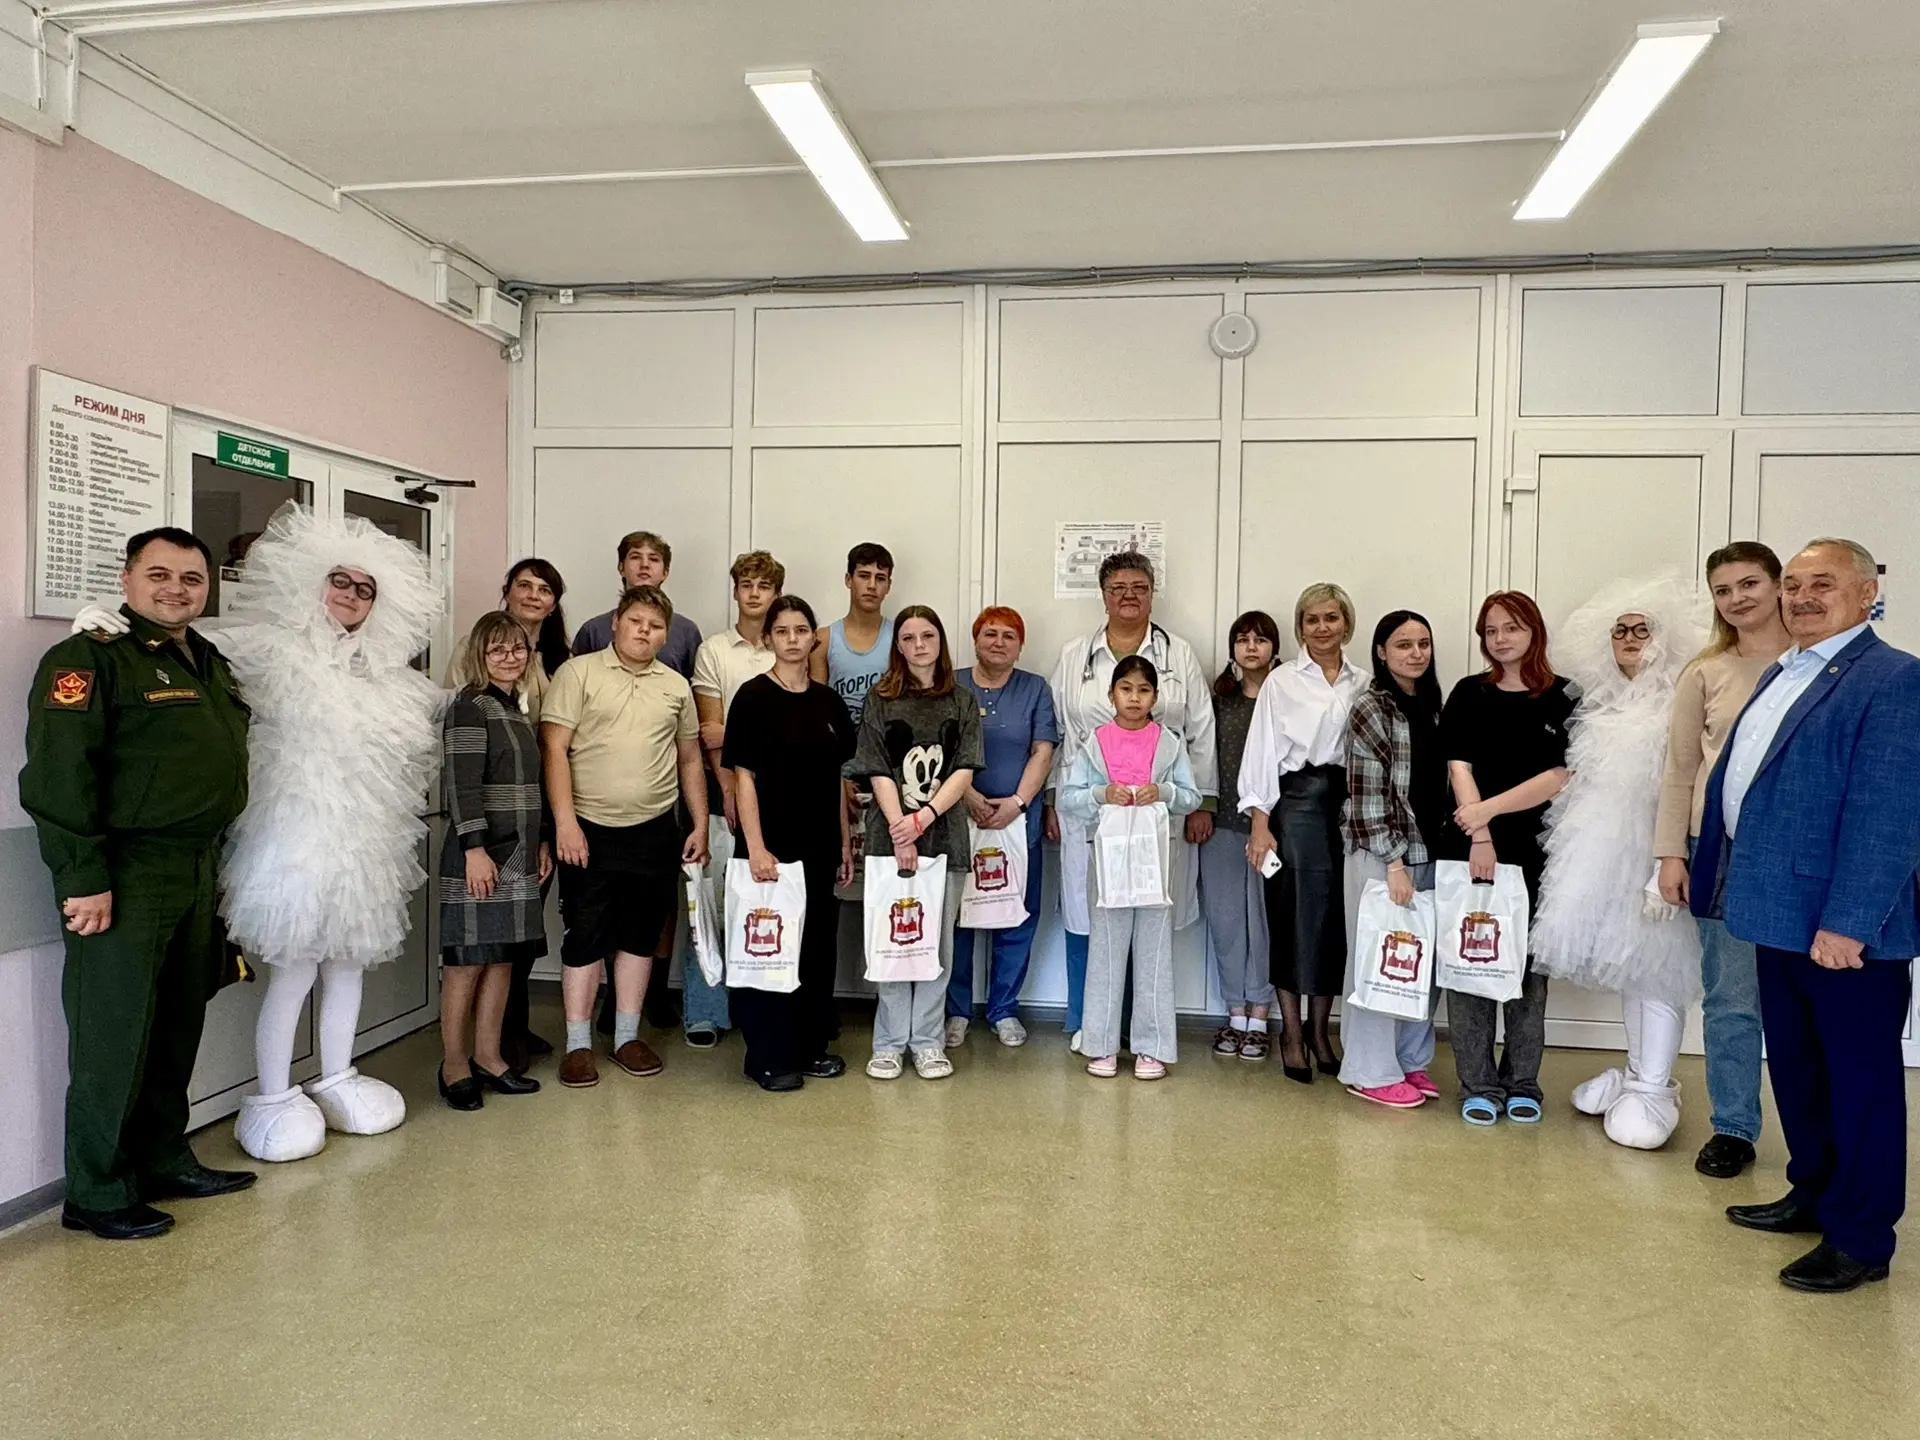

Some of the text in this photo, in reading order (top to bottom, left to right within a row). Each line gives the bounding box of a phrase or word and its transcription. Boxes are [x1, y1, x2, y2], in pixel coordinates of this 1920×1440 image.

[52, 404, 82, 419] Детского
[84, 415, 130, 432] соматического
[75, 395, 145, 424] РЕЖИМ ДНЯ
[237, 442, 272, 458] ДЕТСКОЕ
[232, 453, 276, 471] ОТДЕЛЕНИЕ
